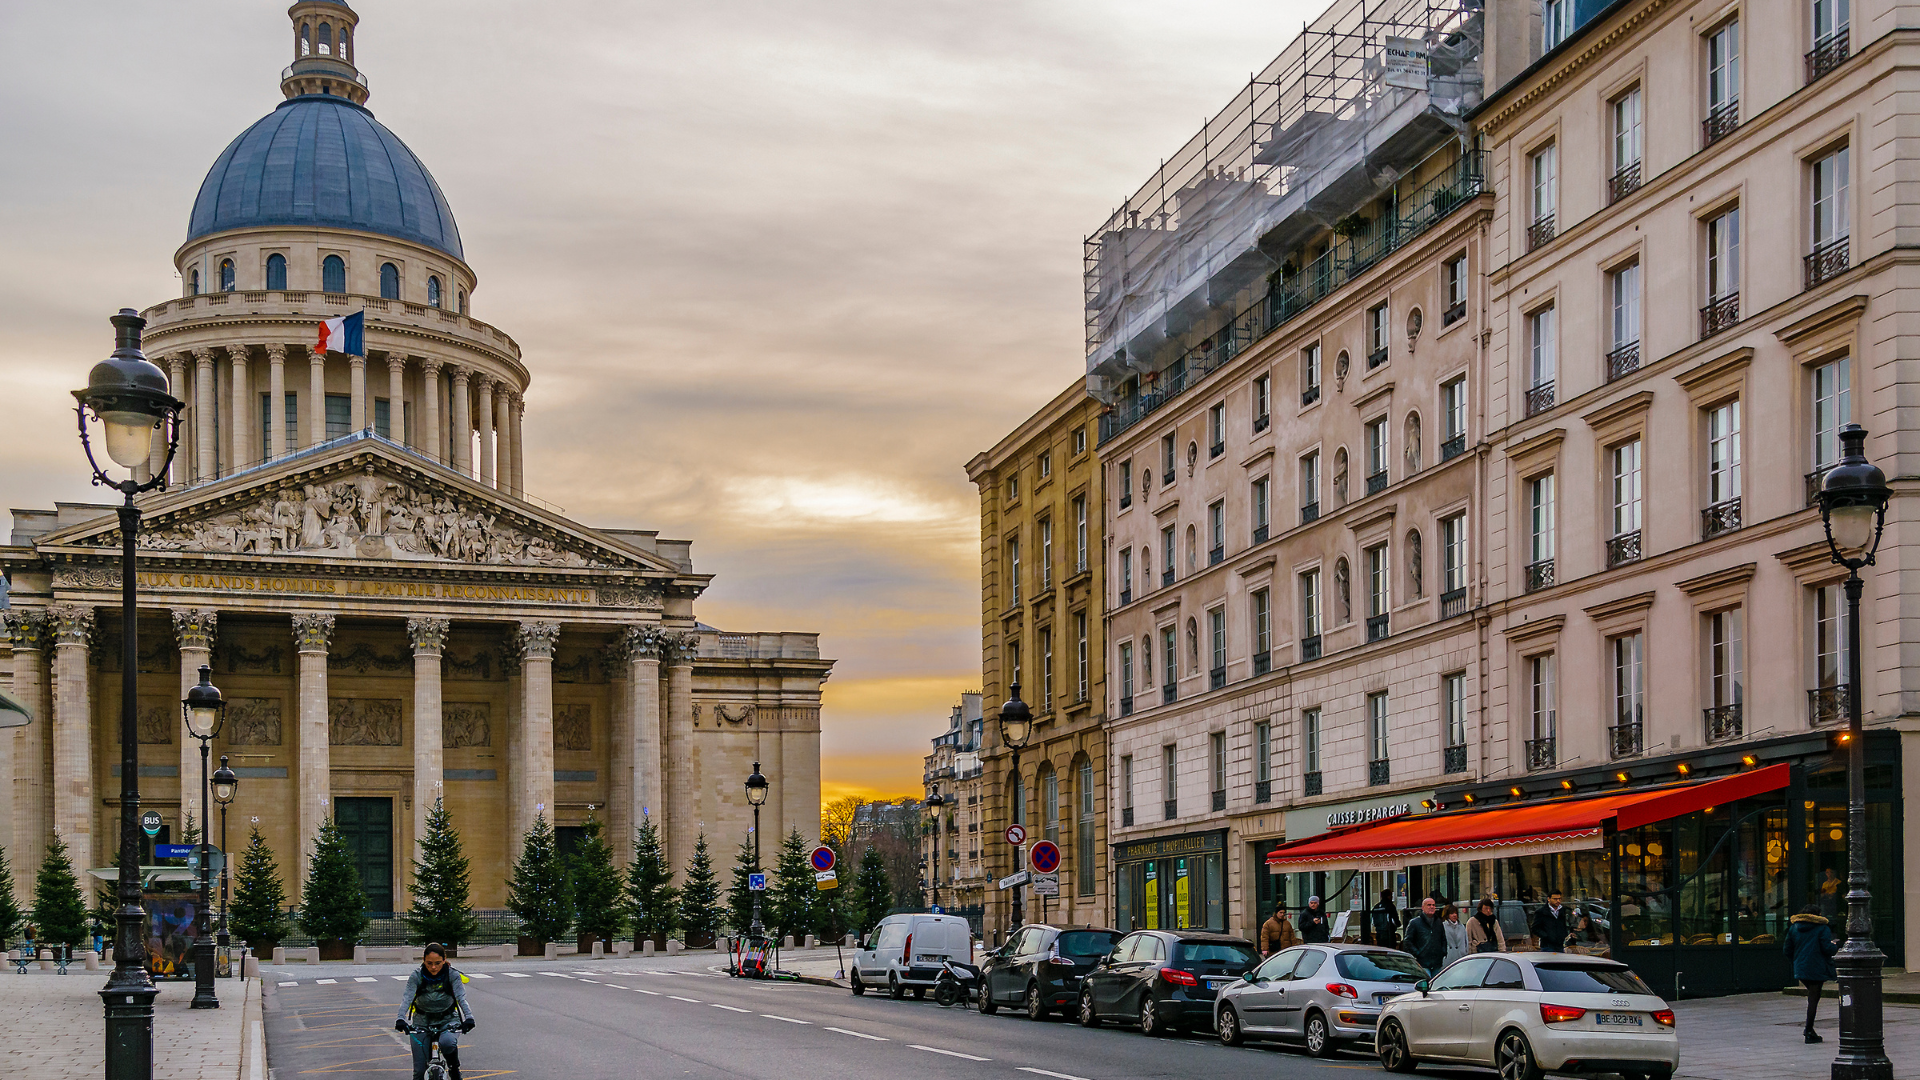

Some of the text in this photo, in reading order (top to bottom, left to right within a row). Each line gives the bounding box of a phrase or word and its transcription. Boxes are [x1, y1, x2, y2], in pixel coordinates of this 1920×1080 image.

[1387, 48, 1426, 59] ECHAFORM
[137, 573, 591, 603] AUX GRANDS HOMMES LA PATRIE RECONNAISSANTE
[144, 816, 160, 825] BUS
[1326, 812, 1355, 826] CAISSE
[1127, 842, 1158, 857] PHARMACIE
[1600, 1014, 1638, 1024] BE-023-BX
